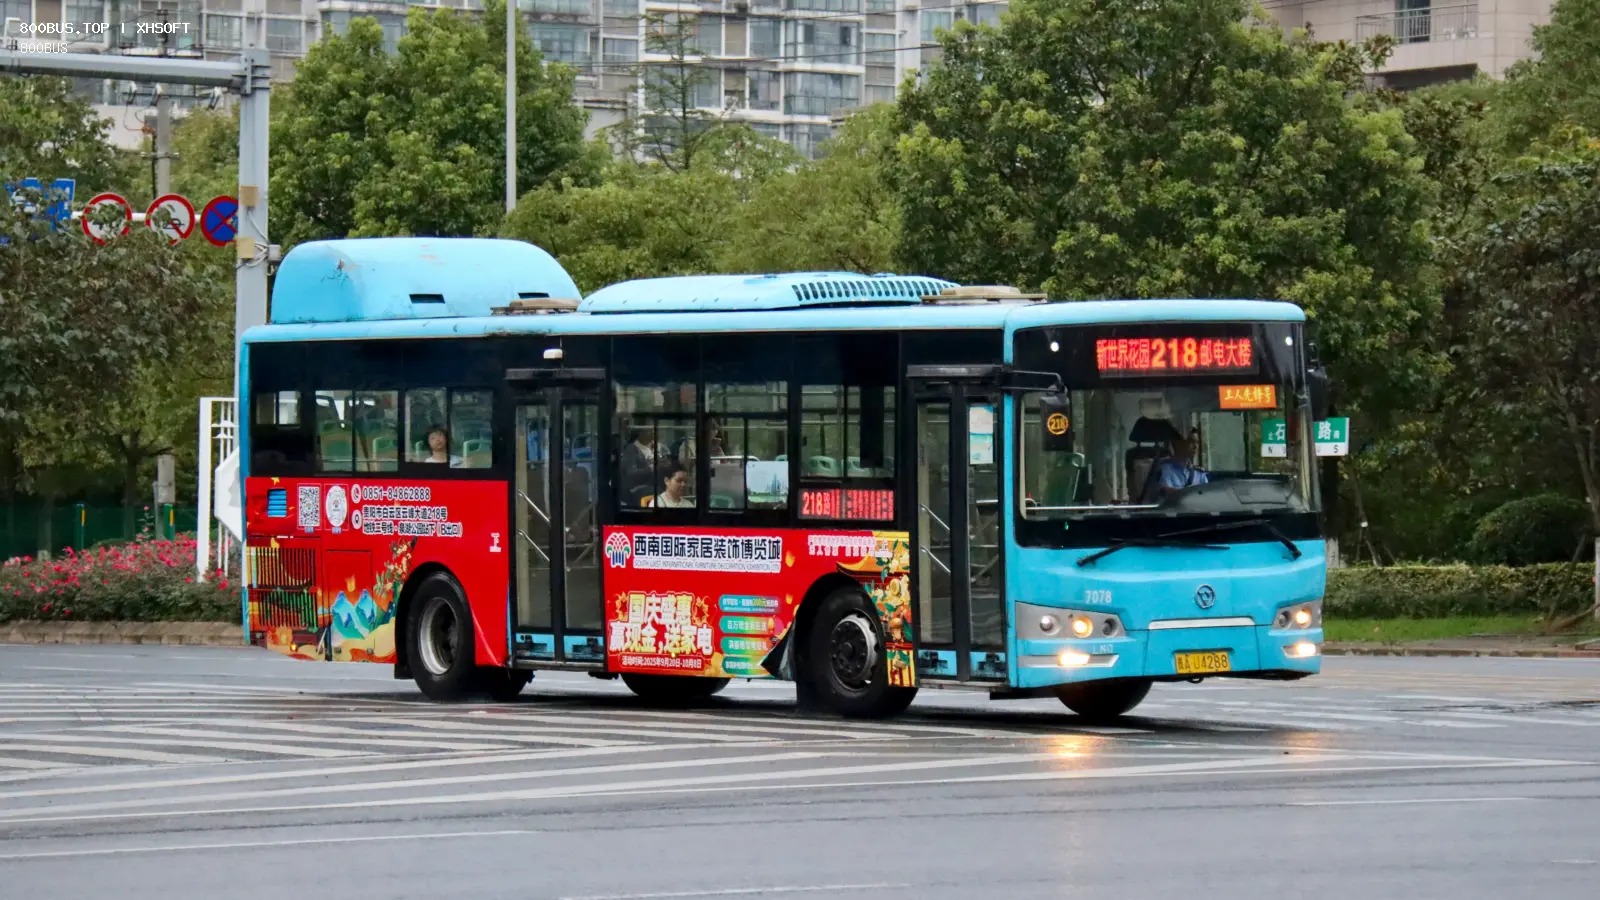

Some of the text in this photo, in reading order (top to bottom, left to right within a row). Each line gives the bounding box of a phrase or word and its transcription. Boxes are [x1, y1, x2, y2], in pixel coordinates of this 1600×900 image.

[1096, 338, 1252, 370] 新世界花园 218 邮电大楼
[1050, 417, 1067, 430] 218
[362, 486, 430, 501] 0851-84862888
[634, 535, 781, 560] 西南国际家居装饰博览城
[1085, 590, 1112, 604] 7078
[629, 593, 693, 626] 国庆盛惠
